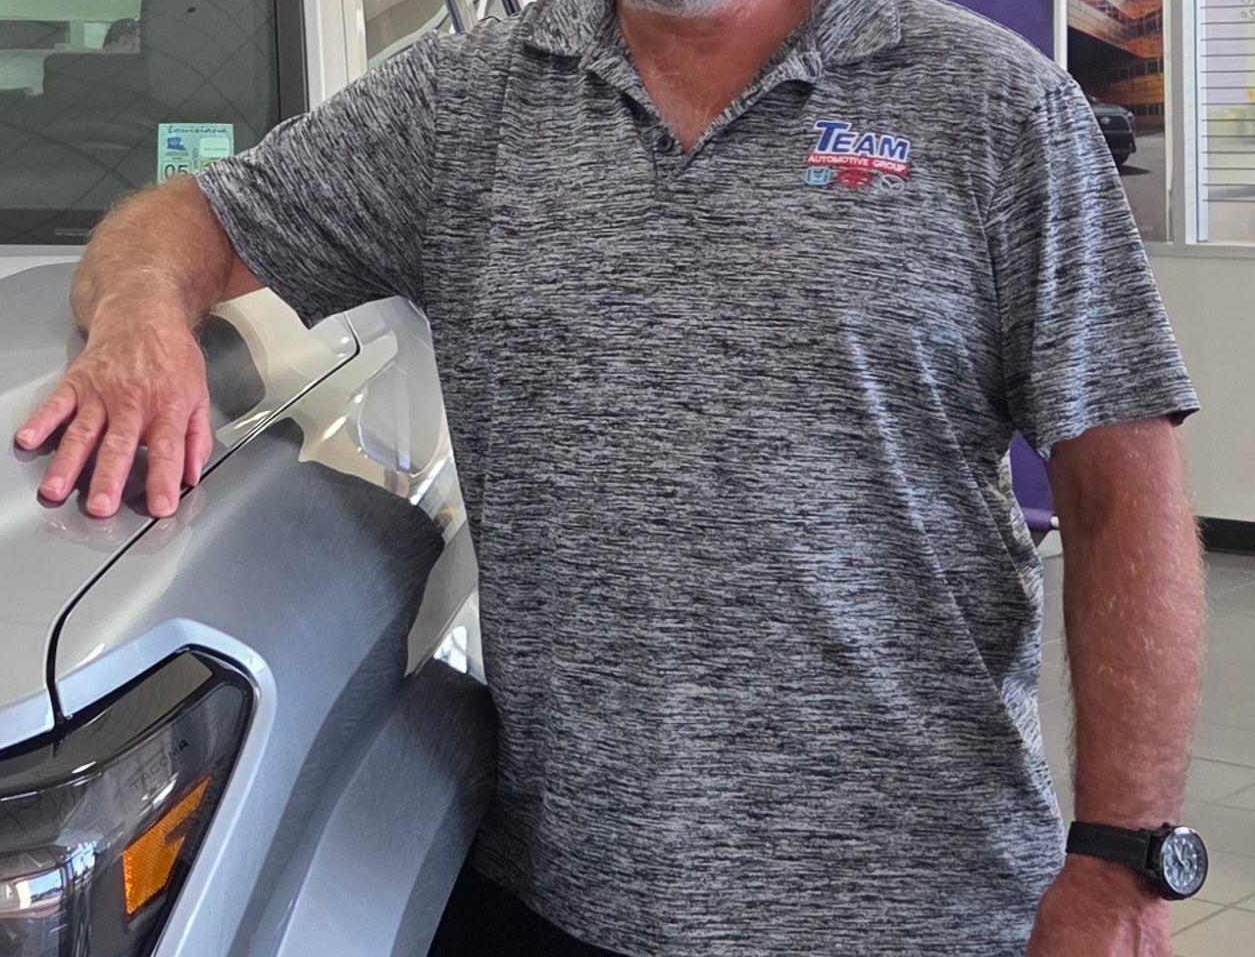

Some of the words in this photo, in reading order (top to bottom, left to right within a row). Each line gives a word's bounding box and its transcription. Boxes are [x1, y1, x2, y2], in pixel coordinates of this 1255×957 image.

[814, 120, 910, 162] TEAM
[807, 154, 870, 166] AUTOMOTIVE
[872, 160, 907, 173] GROUP
